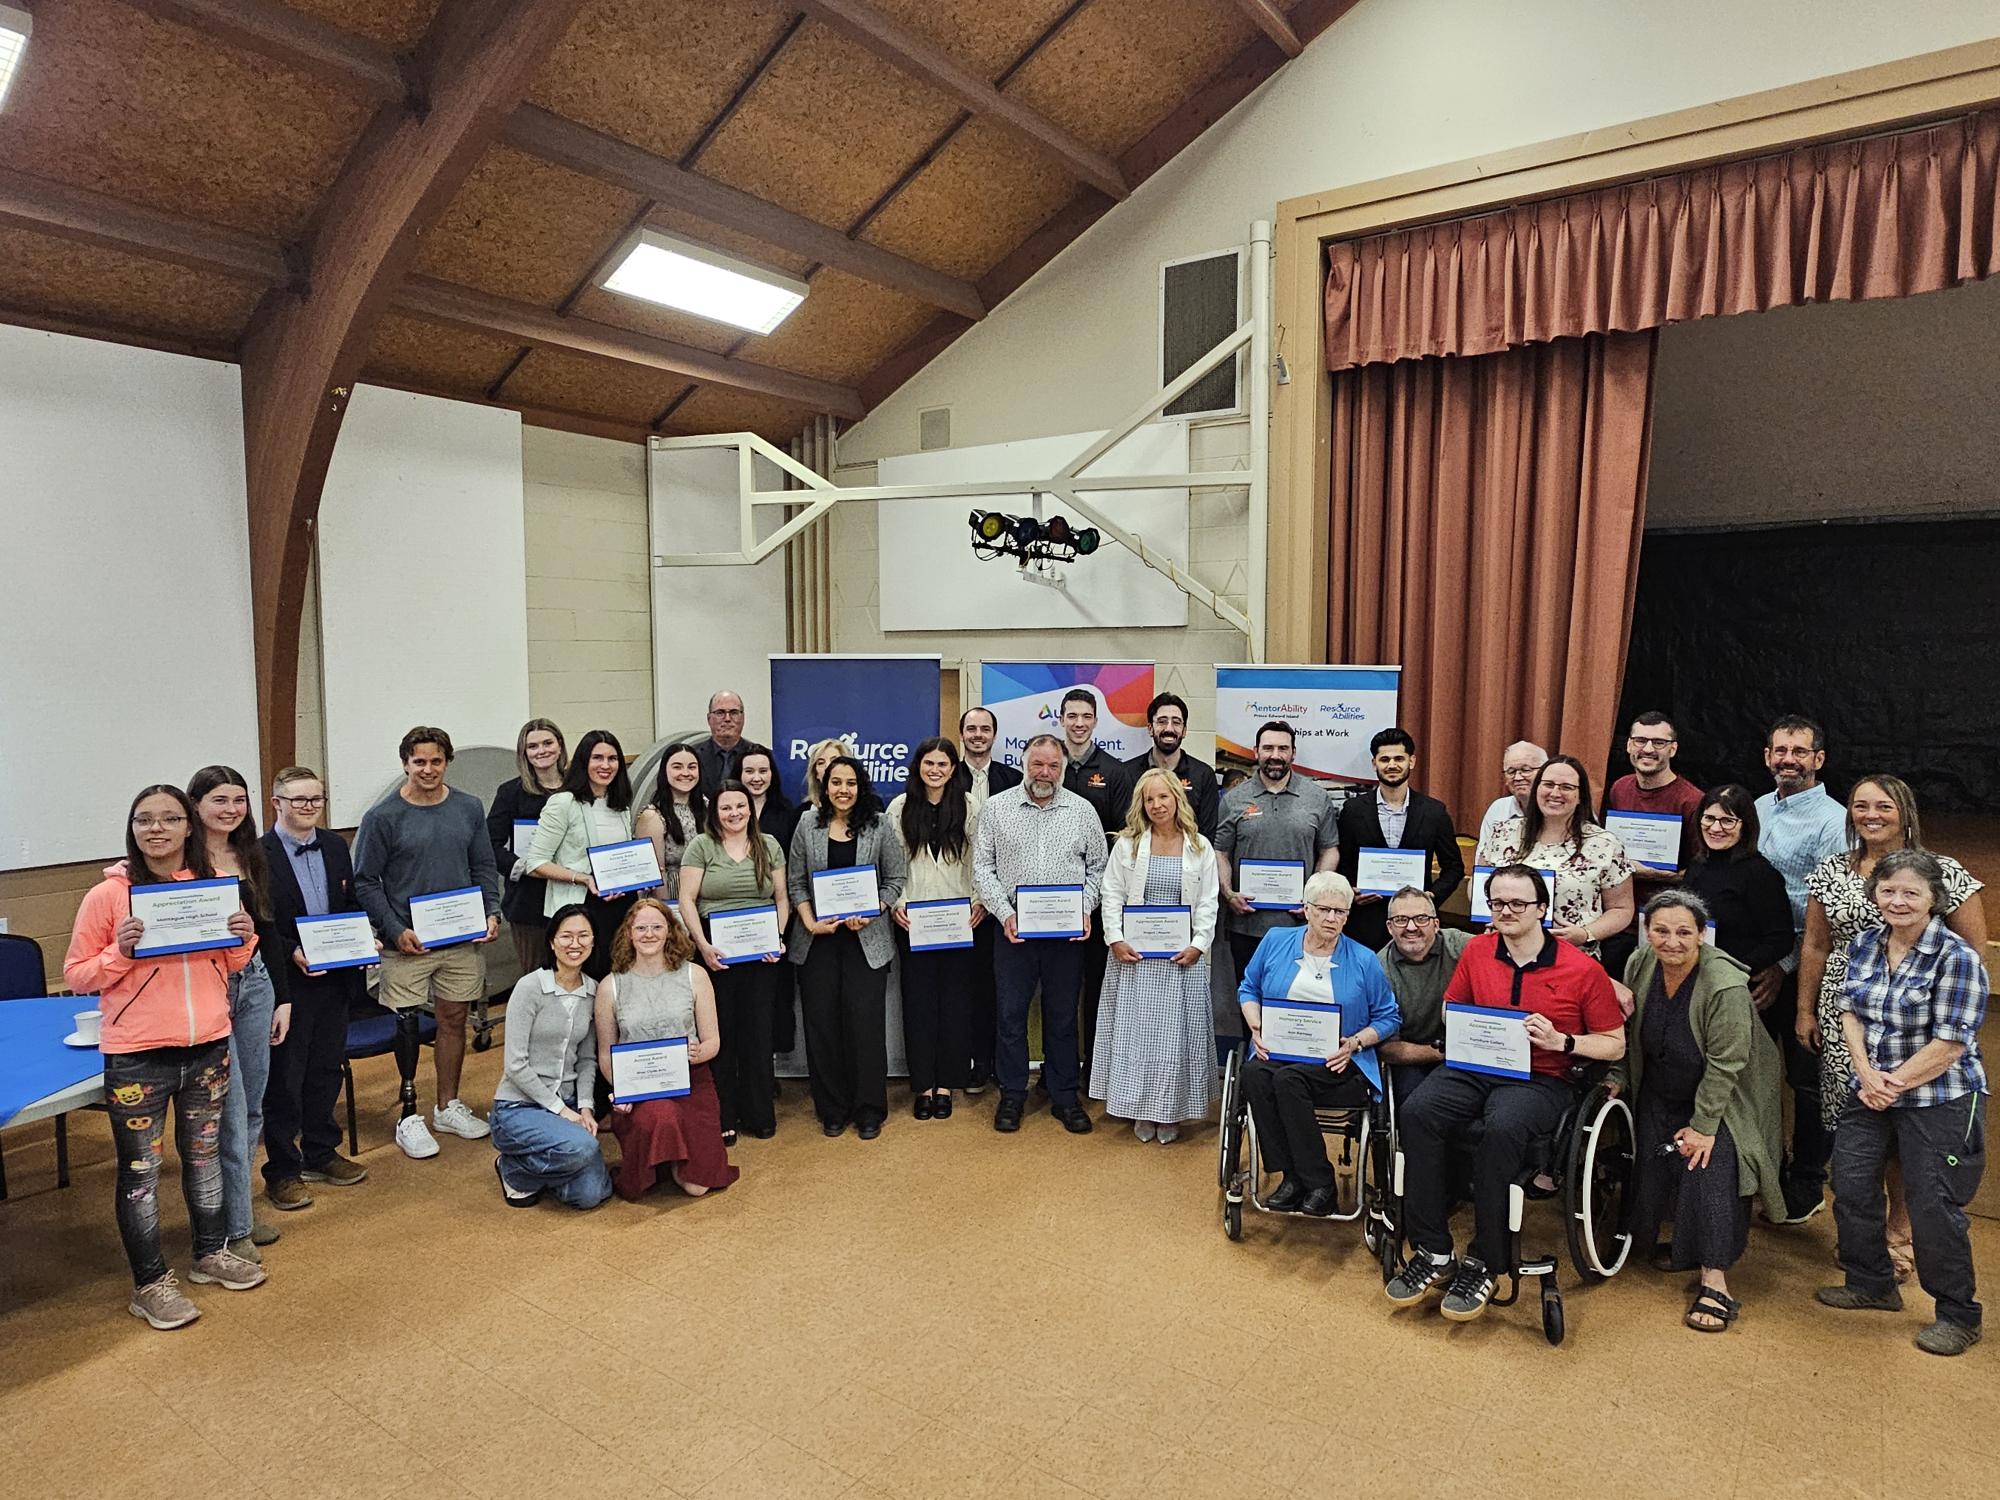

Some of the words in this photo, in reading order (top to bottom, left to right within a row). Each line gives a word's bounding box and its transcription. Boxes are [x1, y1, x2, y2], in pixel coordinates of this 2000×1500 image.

[1320, 703, 1361, 713] Resource
[1331, 712, 1365, 720] Abilities
[1326, 729, 1349, 737] Work
[152, 899, 197, 908] Appreciation
